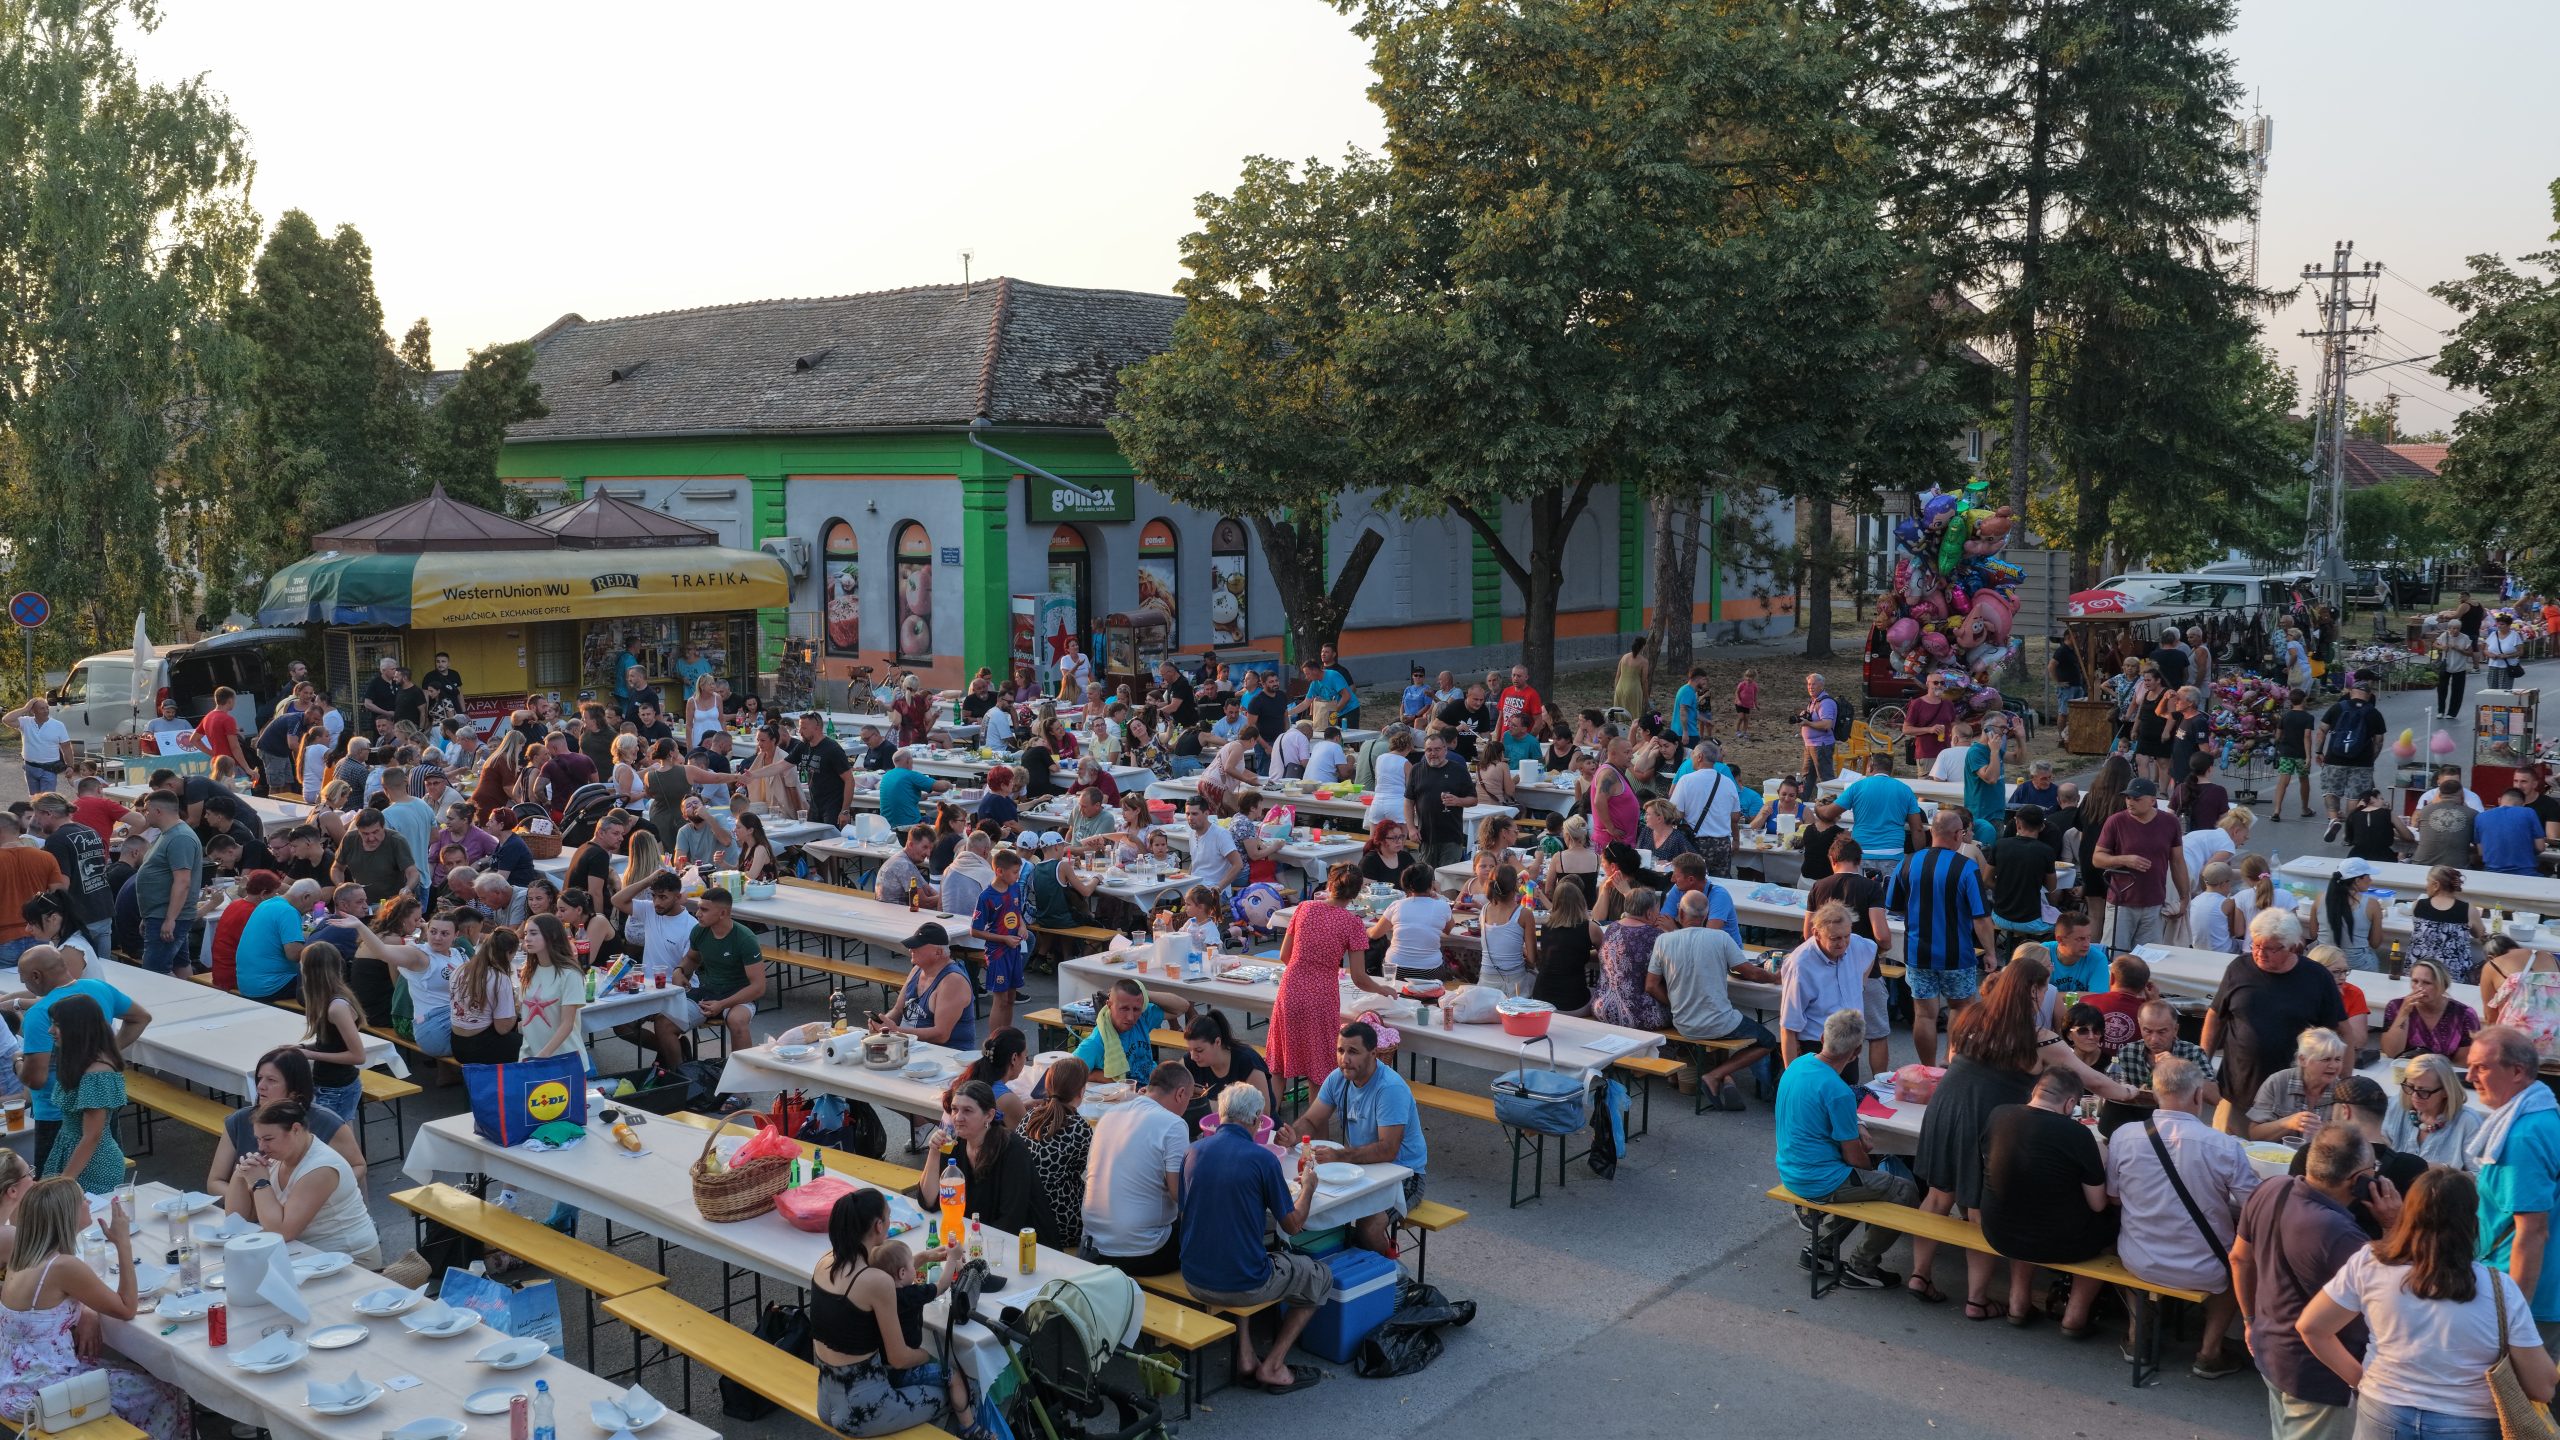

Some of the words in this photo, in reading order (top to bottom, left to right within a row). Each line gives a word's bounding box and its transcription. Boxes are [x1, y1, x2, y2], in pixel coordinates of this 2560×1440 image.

[595, 574, 634, 590] REDA
[671, 572, 749, 588] TRAFIKA
[443, 611, 497, 623] MENJAČNICA
[500, 608, 543, 618] EXCHANGE
[544, 606, 571, 615] OFFICE
